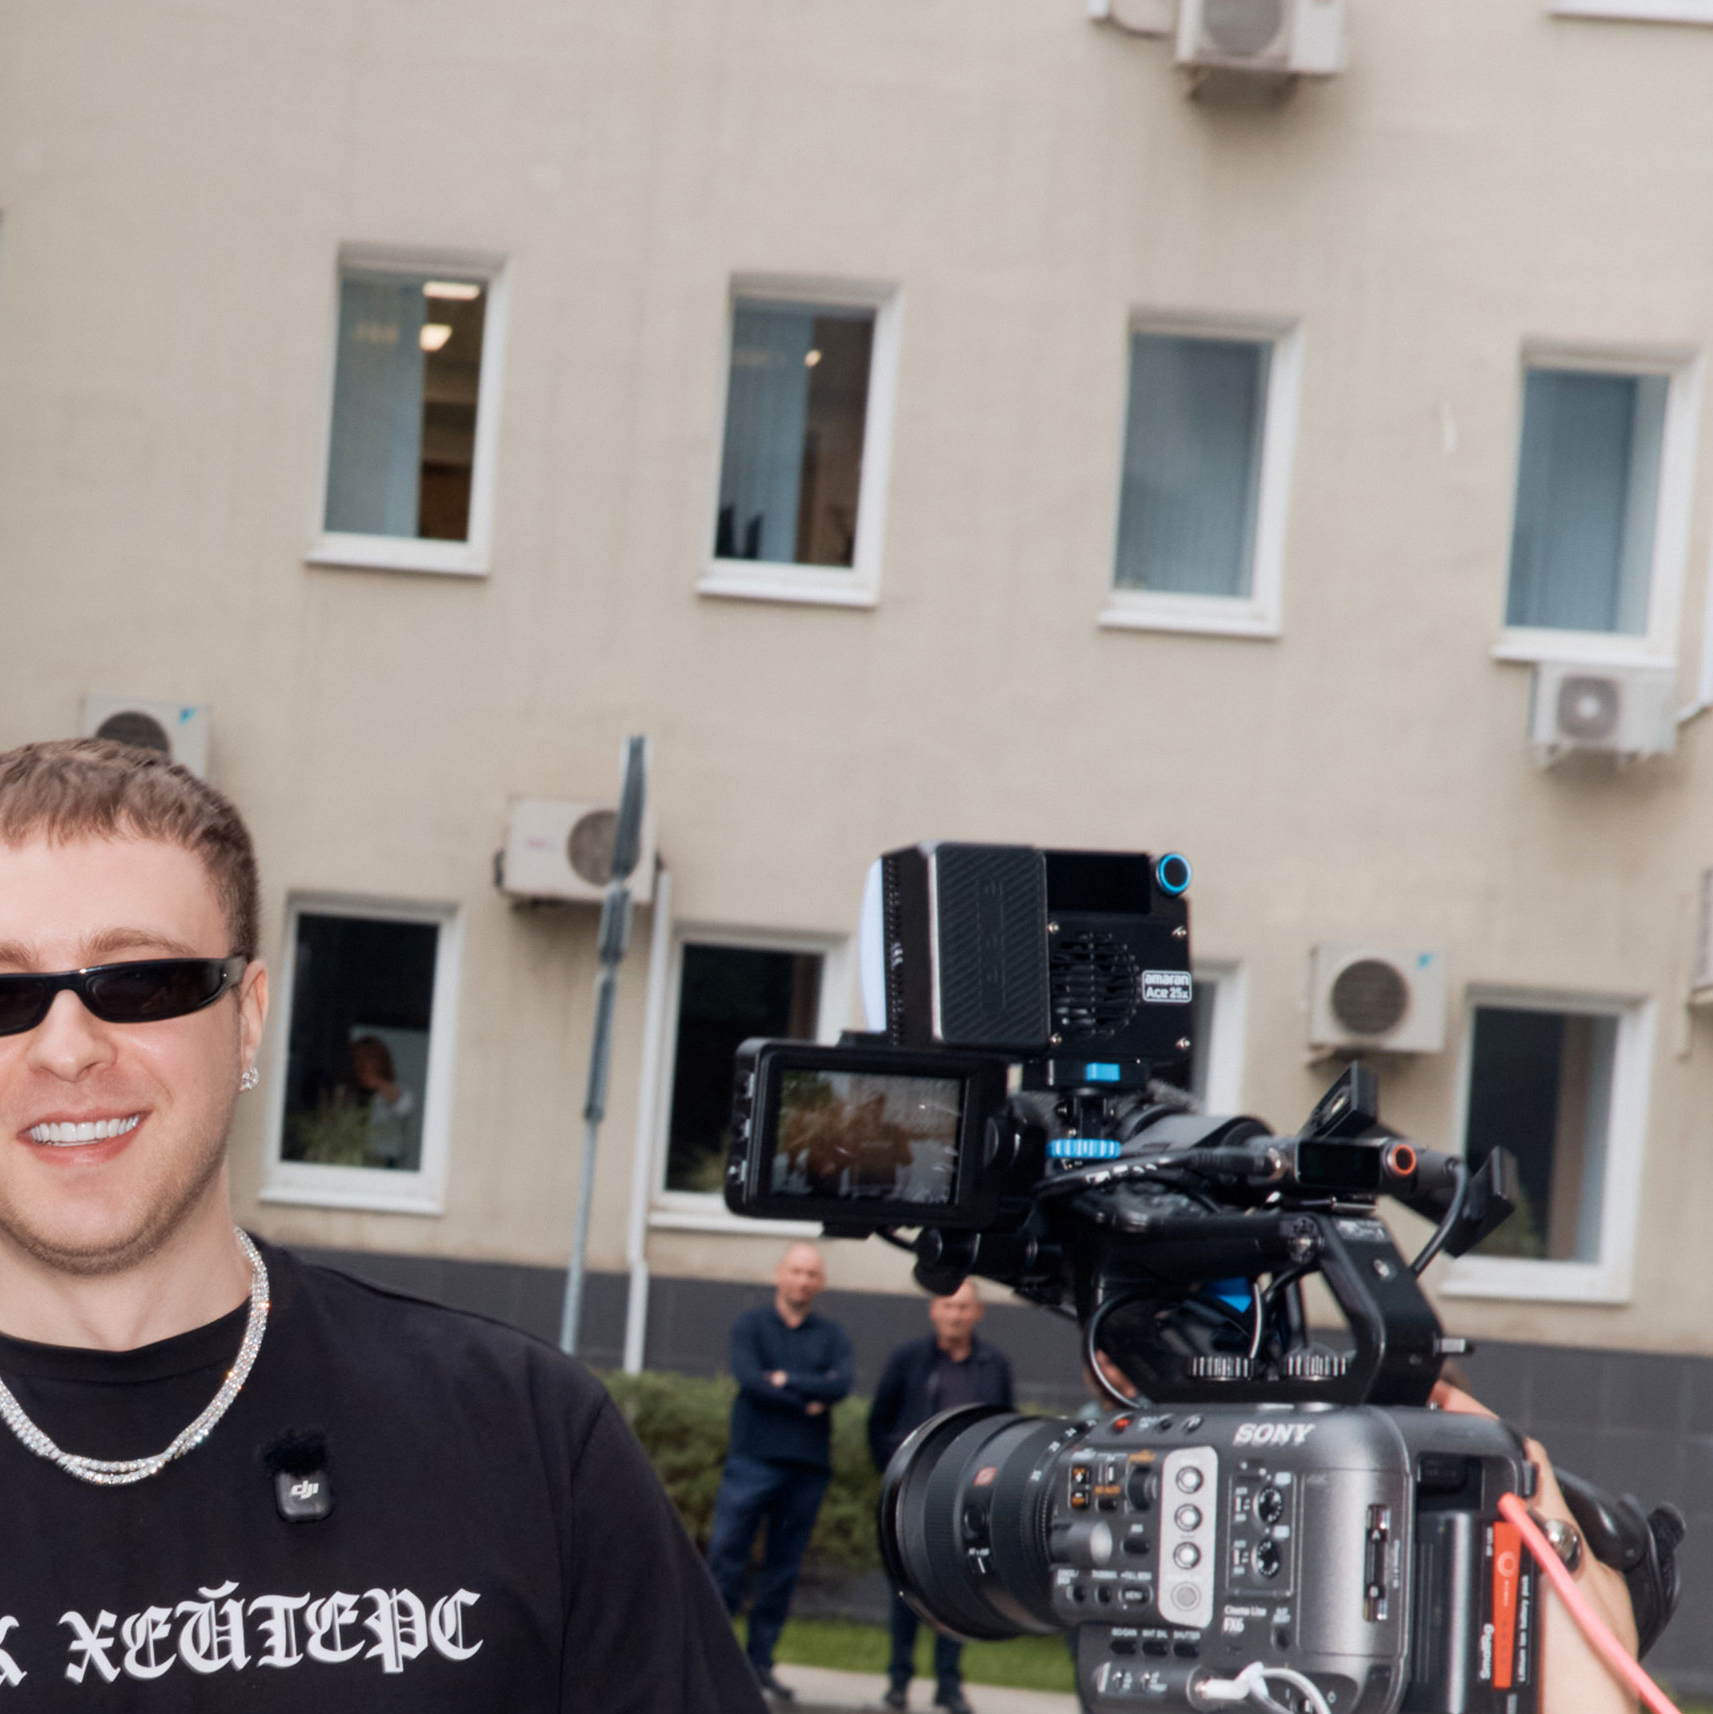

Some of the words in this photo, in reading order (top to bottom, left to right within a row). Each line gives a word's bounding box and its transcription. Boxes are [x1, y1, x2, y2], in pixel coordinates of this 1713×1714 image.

[1145, 974, 1189, 986] amaran
[1146, 986, 1168, 998] Ace
[1234, 1422, 1316, 1445] SONY
[57, 1579, 483, 1685] ХЕЙТЕРС
[1223, 1617, 1245, 1633] FX6
